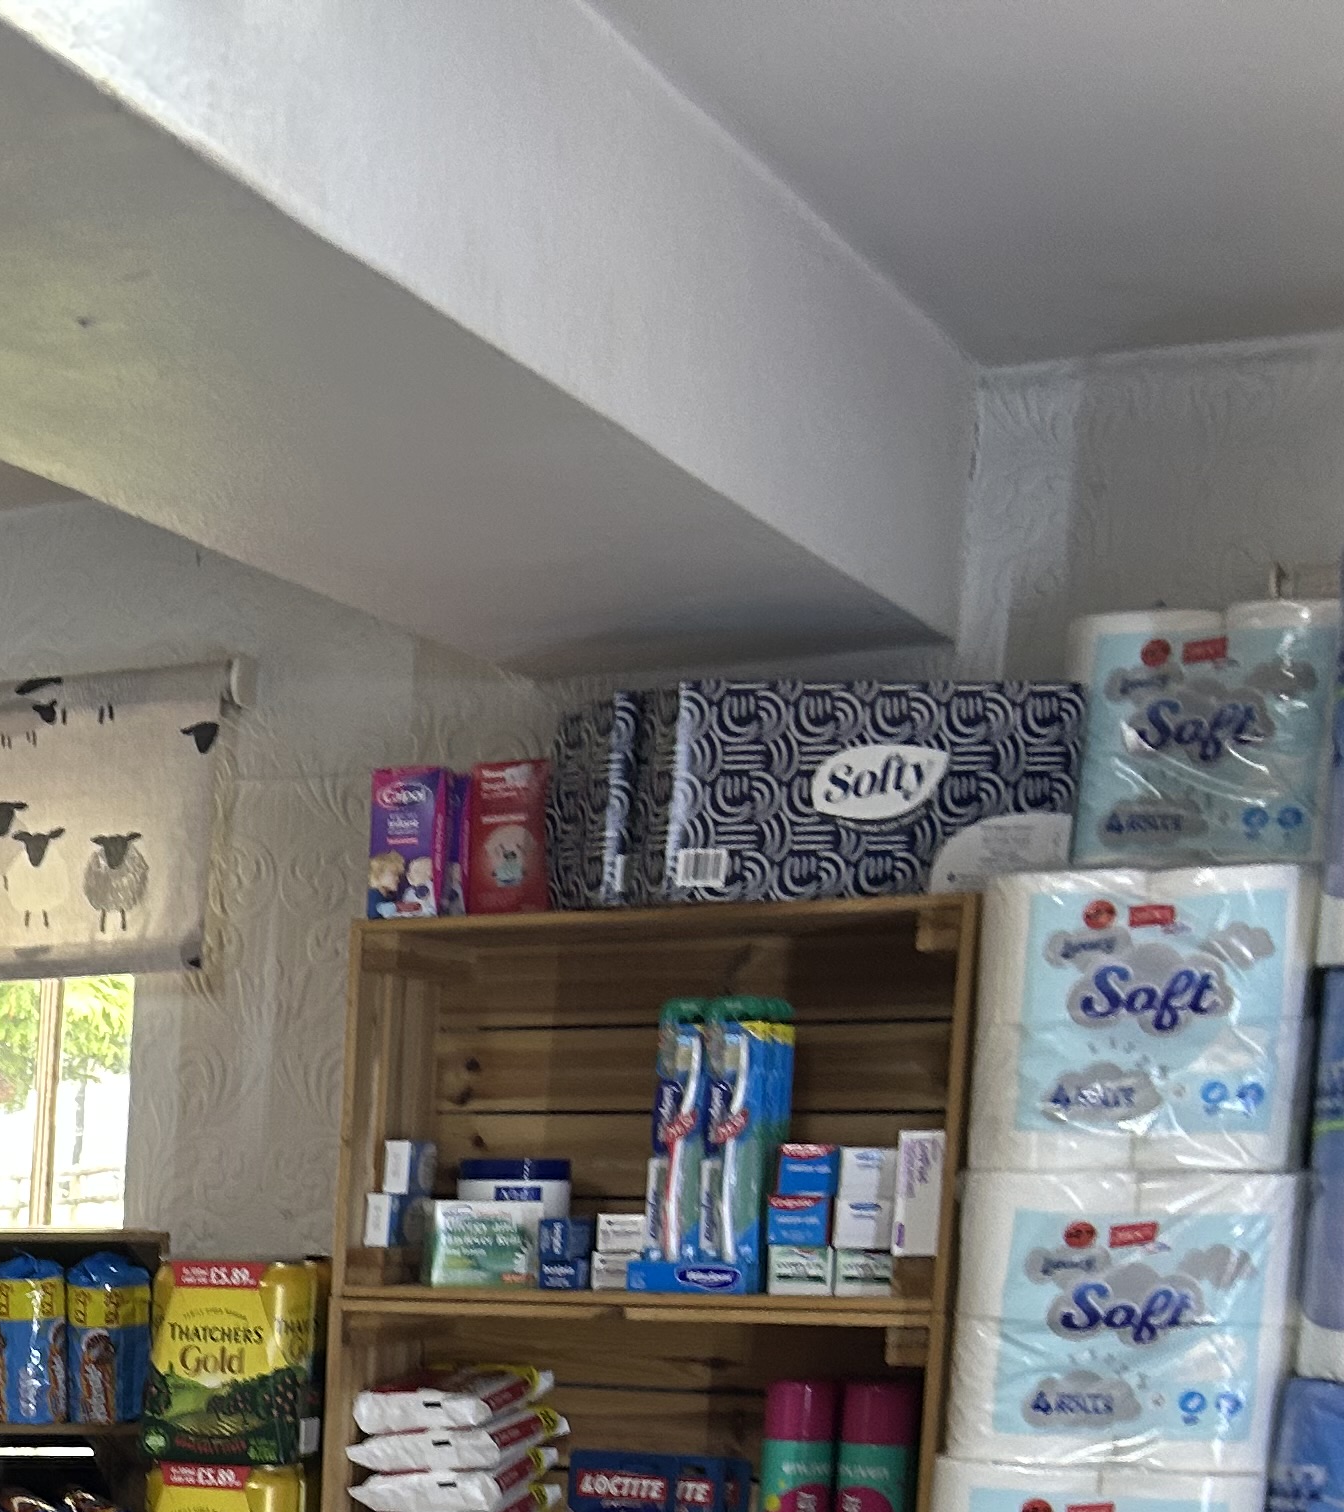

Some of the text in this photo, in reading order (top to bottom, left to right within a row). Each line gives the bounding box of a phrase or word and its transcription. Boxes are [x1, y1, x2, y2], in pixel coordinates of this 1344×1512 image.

[1138, 700, 1258, 763] Soft
[823, 758, 936, 804] Softy
[1079, 965, 1214, 1033] Soft
[169, 1321, 265, 1345] THATCHERS
[1062, 1282, 1193, 1346] Soft
[179, 1344, 246, 1377] Gold
[580, 1473, 667, 1500] LOCTITE
